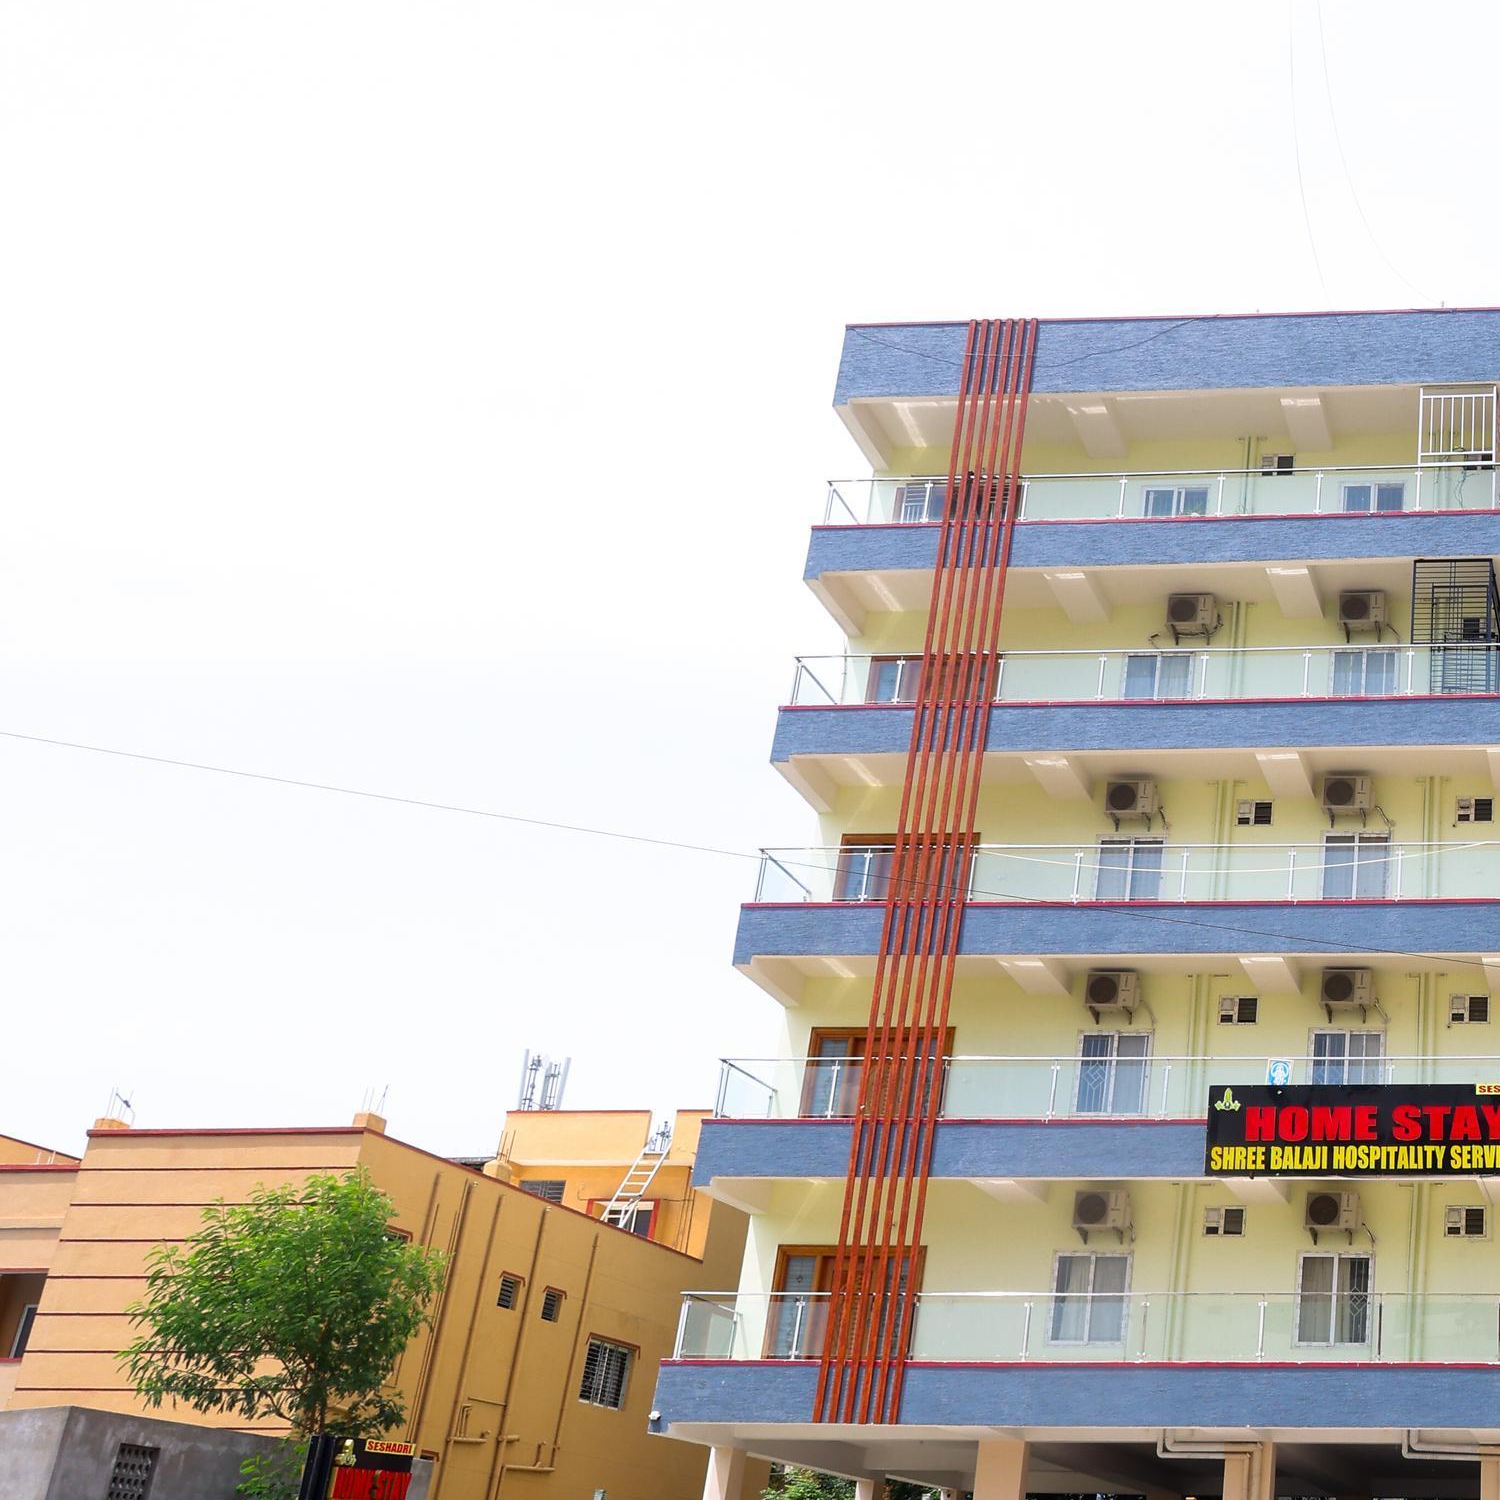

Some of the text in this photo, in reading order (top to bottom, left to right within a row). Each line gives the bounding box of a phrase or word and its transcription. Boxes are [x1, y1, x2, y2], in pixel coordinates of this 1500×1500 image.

[1245, 1105, 1378, 1141] HOME
[1210, 1145, 1266, 1171] SHREE
[1270, 1145, 1328, 1170] BALAJI
[1333, 1145, 1446, 1170] HOSPITALITY
[367, 1441, 412, 1454] SESHADRI
[332, 1467, 375, 1500] HOME
